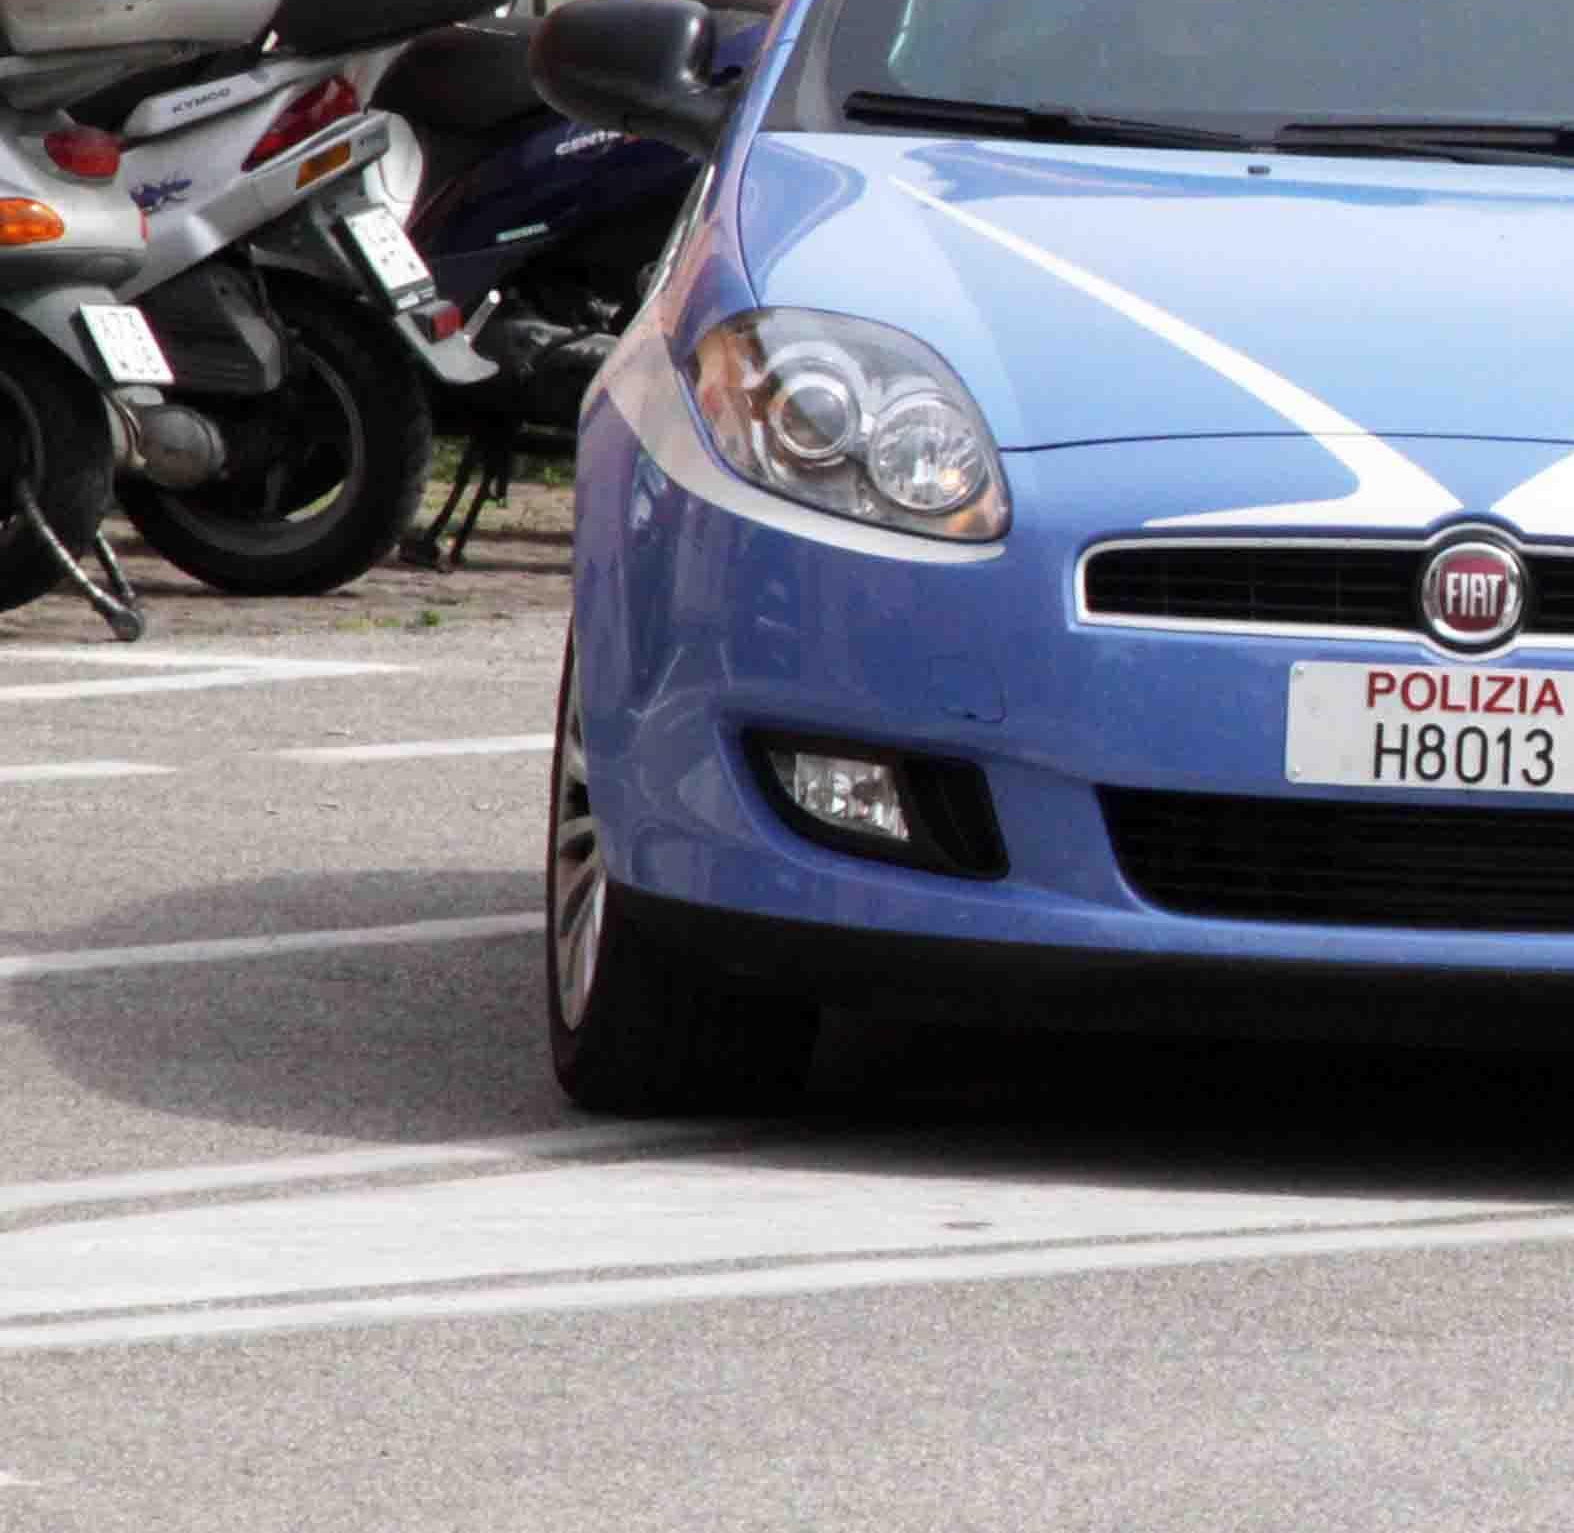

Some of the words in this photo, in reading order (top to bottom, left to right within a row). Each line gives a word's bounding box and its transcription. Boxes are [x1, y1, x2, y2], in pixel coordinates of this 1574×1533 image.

[171, 87, 232, 115] KYMCO
[1444, 571, 1505, 619] FIAT
[1366, 671, 1565, 717] POLIZIA
[1373, 722, 1554, 787] H8013
